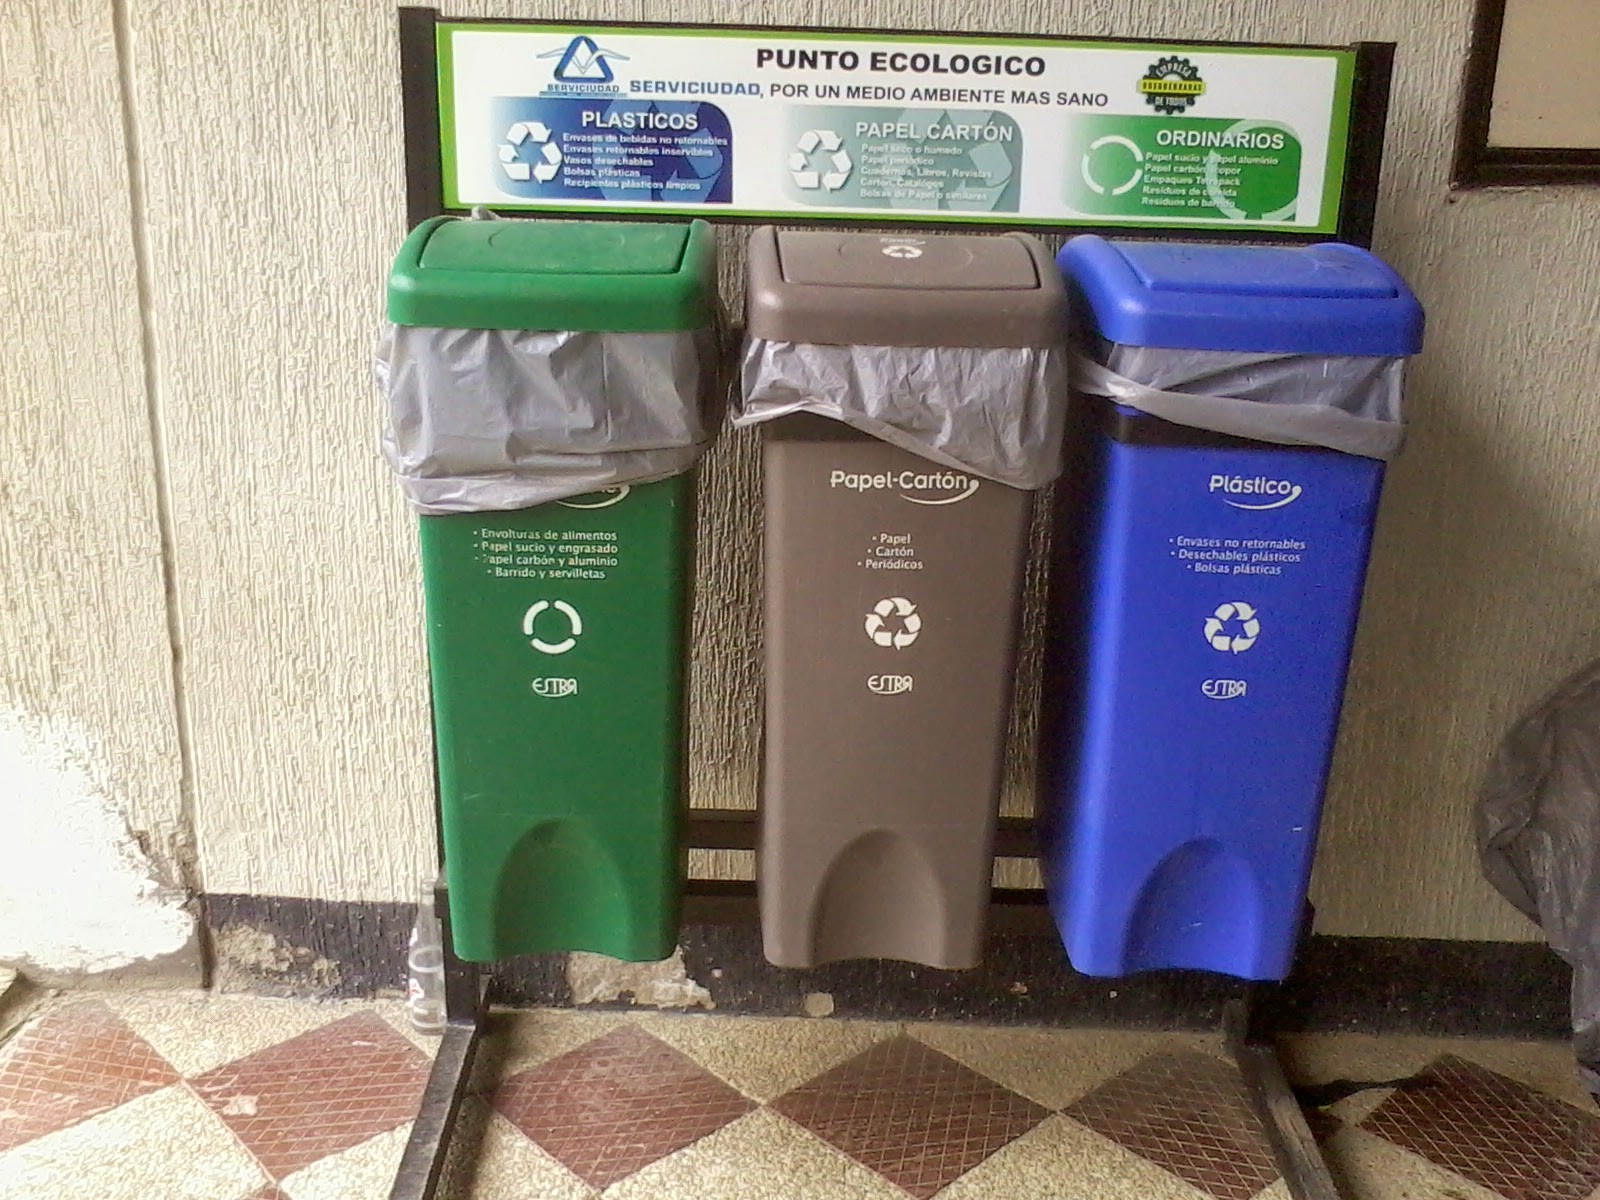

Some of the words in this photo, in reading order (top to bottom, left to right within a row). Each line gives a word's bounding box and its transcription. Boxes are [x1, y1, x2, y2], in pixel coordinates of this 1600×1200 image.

[757, 49, 859, 71] PUNTO
[870, 52, 1045, 76] ECOLOGICO
[547, 84, 620, 93] SERVICIUDAD
[629, 80, 763, 99] SERVICIUDAD,
[770, 83, 809, 98] POR
[815, 85, 839, 99] UN
[846, 85, 905, 100] MEDIO
[910, 87, 1005, 103] AMBIENTE
[1011, 90, 1051, 105] MAS
[1056, 92, 1109, 107] SANO
[582, 111, 698, 130] PLASTICOS
[856, 122, 922, 139] PAPEL
[927, 121, 1013, 141] CARTÓN
[563, 133, 603, 143] Envases
[605, 134, 617, 143] de
[620, 134, 657, 144] bebidas
[674, 136, 728, 146] retornables
[1156, 129, 1284, 149] ORDINARIOS
[563, 144, 603, 153] Envases
[605, 146, 659, 156] retornables
[861, 143, 889, 153] Papel
[563, 156, 592, 164] Vasos
[594, 156, 653, 166] desechables
[861, 155, 889, 165] Papel
[1145, 152, 1172, 162] Papel
[1174, 153, 1200, 162] sucio
[1238, 155, 1279, 165] aluminio
[563, 167, 596, 176] Bolsas
[1145, 164, 1171, 174] Papel
[1173, 164, 1205, 174] carbón
[564, 178, 619, 189] Recipientes
[1144, 175, 1193, 186] Empaques
[860, 188, 892, 198] Bolsas
[908, 190, 935, 200] Papel
[1143, 186, 1186, 196] Residuos
[1188, 186, 1200, 196] de
[1142, 197, 1185, 207] Residuos
[1188, 198, 1200, 207] de
[830, 470, 968, 493] Papel-Cartón
[1209, 475, 1292, 495] Plástico
[481, 528, 541, 540] Envolturas
[544, 530, 558, 540] de
[562, 530, 618, 541] alimentos
[880, 533, 911, 545] Papel
[481, 542, 512, 553] Papel
[516, 543, 545, 553] sucio
[549, 545, 556, 555] y
[559, 543, 619, 555] engrasado
[1177, 535, 1221, 547] Envases
[1224, 538, 1240, 548] no
[1242, 539, 1306, 550] retornables
[875, 546, 914, 557] Cartón
[1178, 549, 1248, 561] Desechables
[1252, 551, 1301, 563] plásticos
[516, 554, 555, 566] carbón
[558, 557, 566, 567] y
[568, 556, 618, 567] aluminio
[865, 559, 924, 570] Periódicos
[495, 567, 536, 578] Barrido
[539, 570, 546, 579] y
[549, 569, 606, 579] servilletas
[1194, 562, 1230, 574] Bolsas
[1233, 563, 1282, 576] plásticas
[532, 677, 578, 697] ESTRA
[867, 675, 913, 695] ESTRA
[1201, 679, 1248, 699] ESTRA
